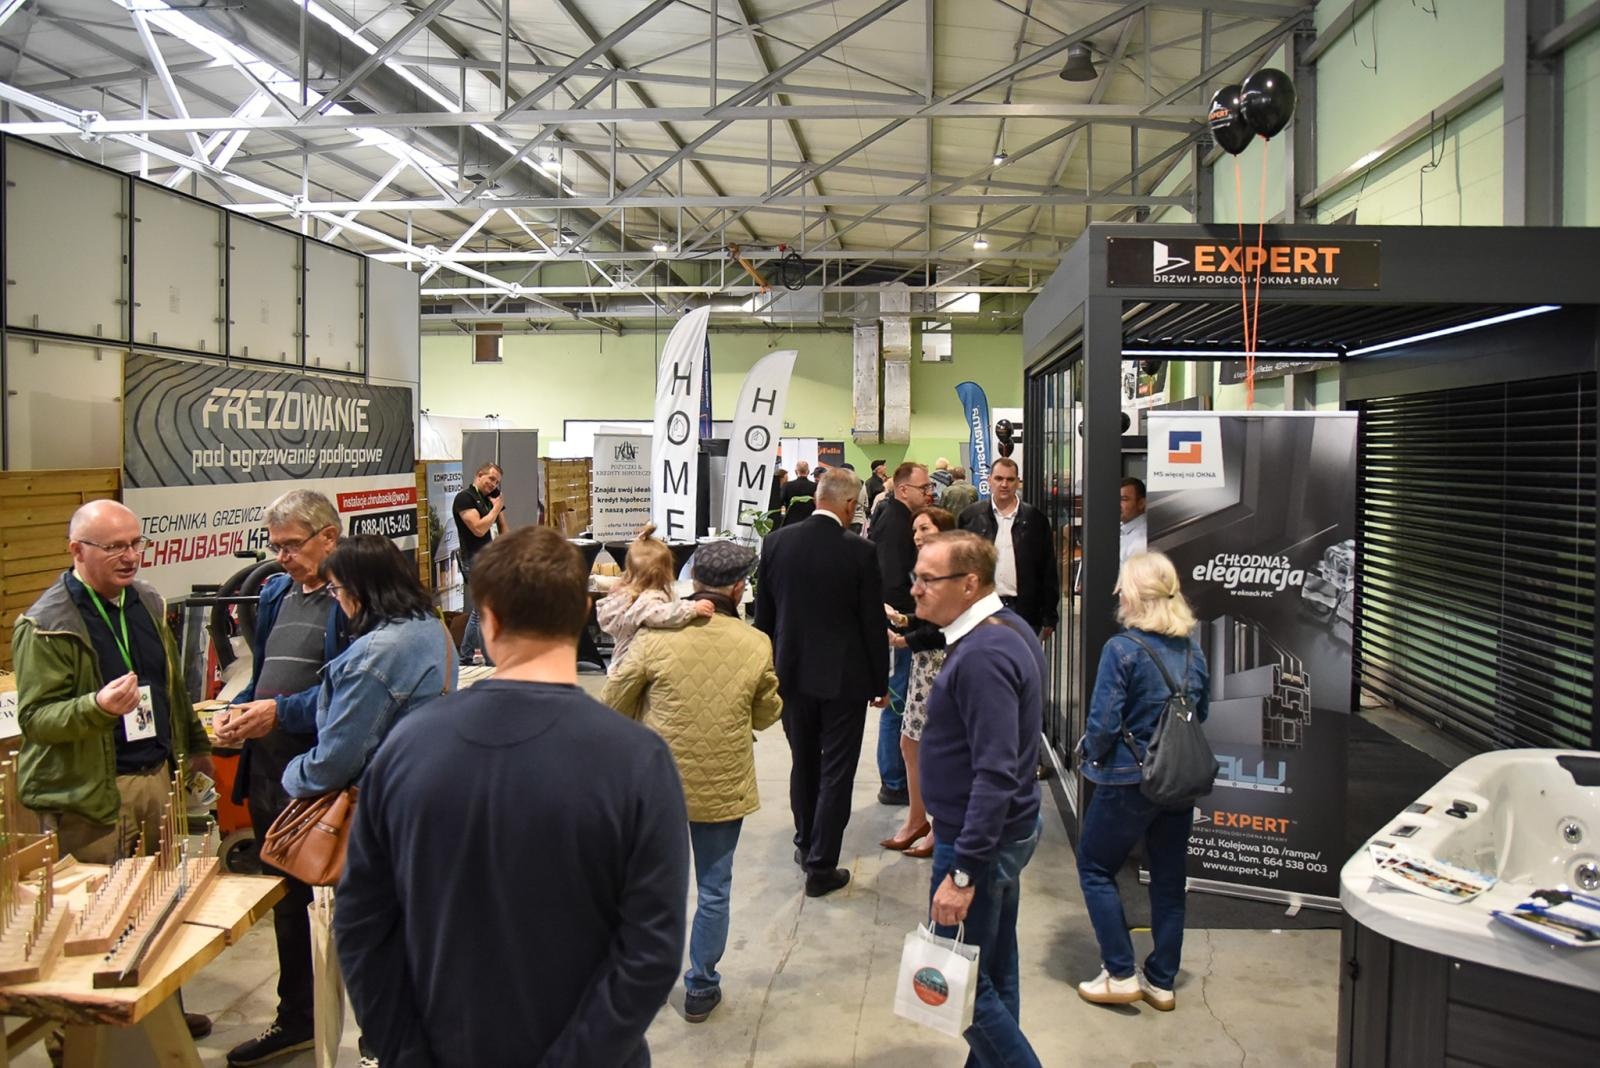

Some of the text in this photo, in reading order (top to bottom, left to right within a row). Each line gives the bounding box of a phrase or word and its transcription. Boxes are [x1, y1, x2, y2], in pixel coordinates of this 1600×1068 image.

[1195, 245, 1340, 274] EXPERT
[1153, 275, 1340, 285] DRZWI PODŁOGI OKNA BRAMY
[202, 387, 371, 433] FREZOWANIE
[193, 443, 383, 475] pod ogrzewanie podłogowe
[1196, 471, 1217, 479] OKNA
[142, 506, 266, 535] TECHNIKA GRZEWCZ
[140, 527, 270, 568] CHRUBASIK KR
[1215, 553, 1290, 569] CHŁODNA?
[1192, 559, 1305, 592] elegancja
[1260, 590, 1274, 598] PVC
[1213, 810, 1290, 834] EXPERT
[1187, 846, 1205, 857] 307
[1207, 849, 1220, 859] 43
[1238, 853, 1261, 865] kom.
[1263, 856, 1283, 867] 664
[1285, 859, 1305, 870] 538
[1307, 862, 1328, 874] 003
[1205, 837, 1216, 847] ul.
[1218, 839, 1260, 853] Kolejowa
[1262, 845, 1280, 855] 10a
[1281, 847, 1321, 861] /rampa/
[1203, 861, 1279, 880] www.expert-1.pl
